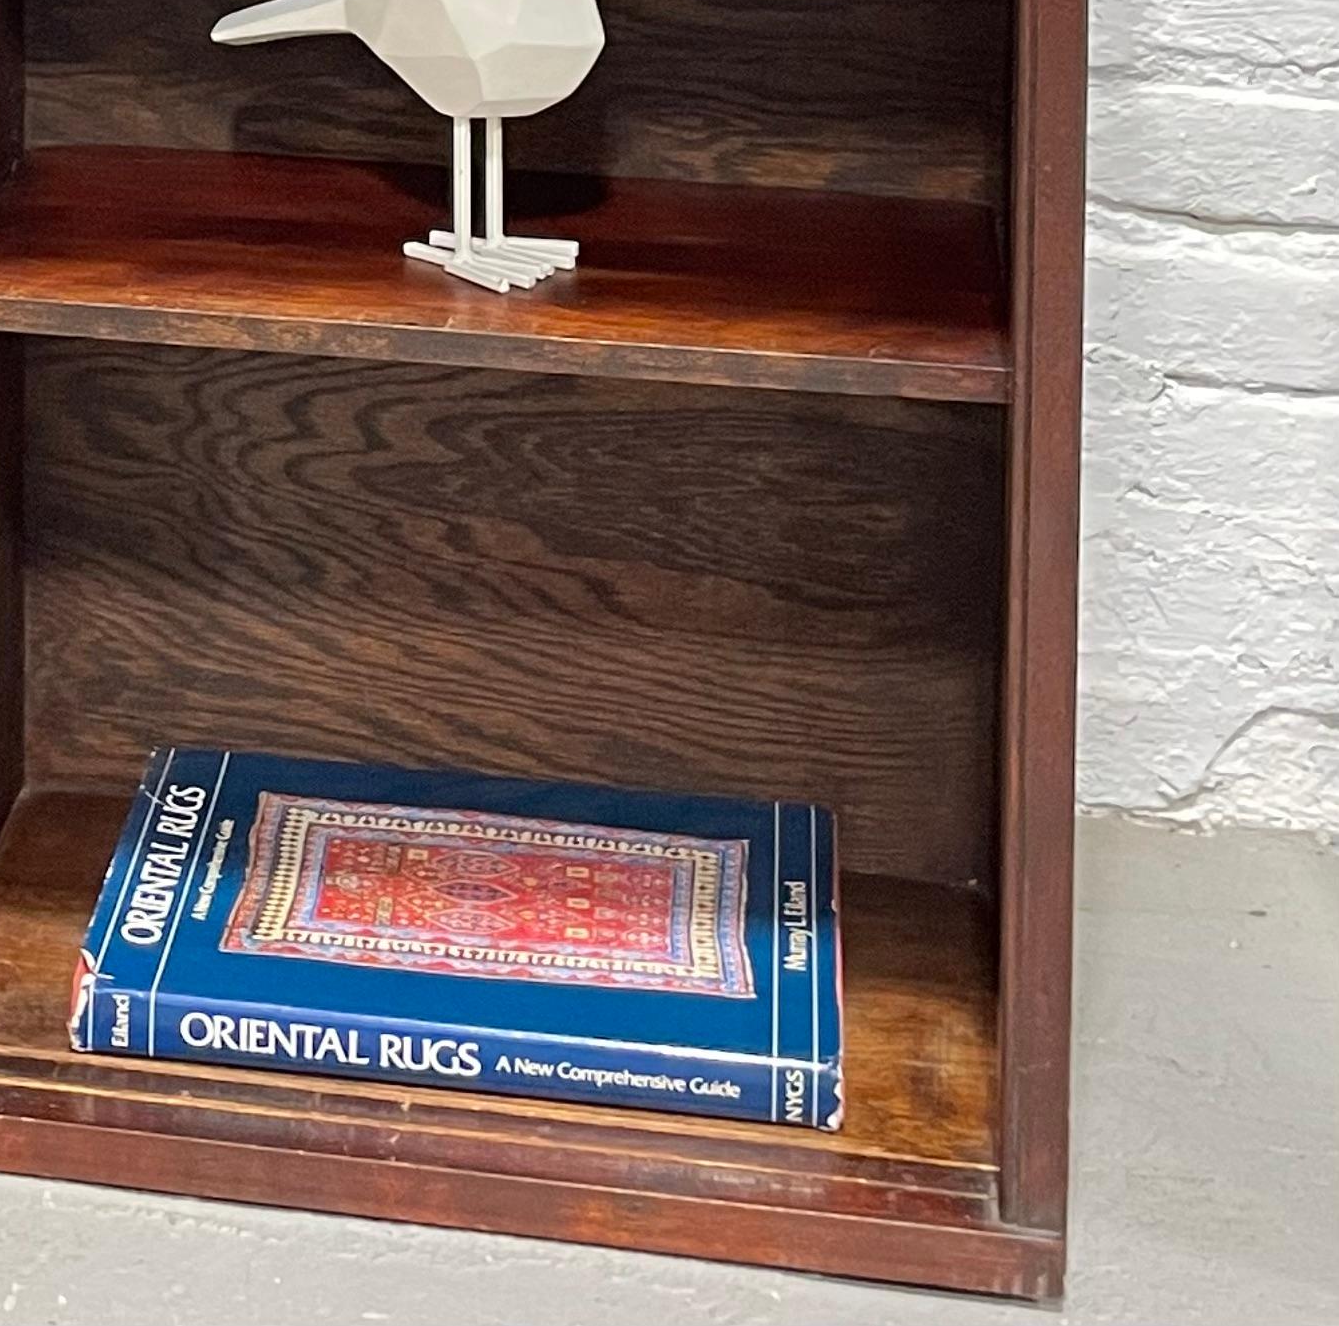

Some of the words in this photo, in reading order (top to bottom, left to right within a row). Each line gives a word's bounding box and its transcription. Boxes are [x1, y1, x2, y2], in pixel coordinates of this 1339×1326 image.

[120, 841, 191, 946] ORIENTAL
[156, 784, 207, 839] RUGS
[179, 1012, 370, 1066] ORIENTAL
[378, 1033, 482, 1077] RUGS
[494, 1055, 511, 1072] A
[514, 1059, 555, 1077] New
[557, 1061, 687, 1093] Comprehensive
[689, 1077, 742, 1099] Guide
[785, 1069, 804, 1123] NYGS
